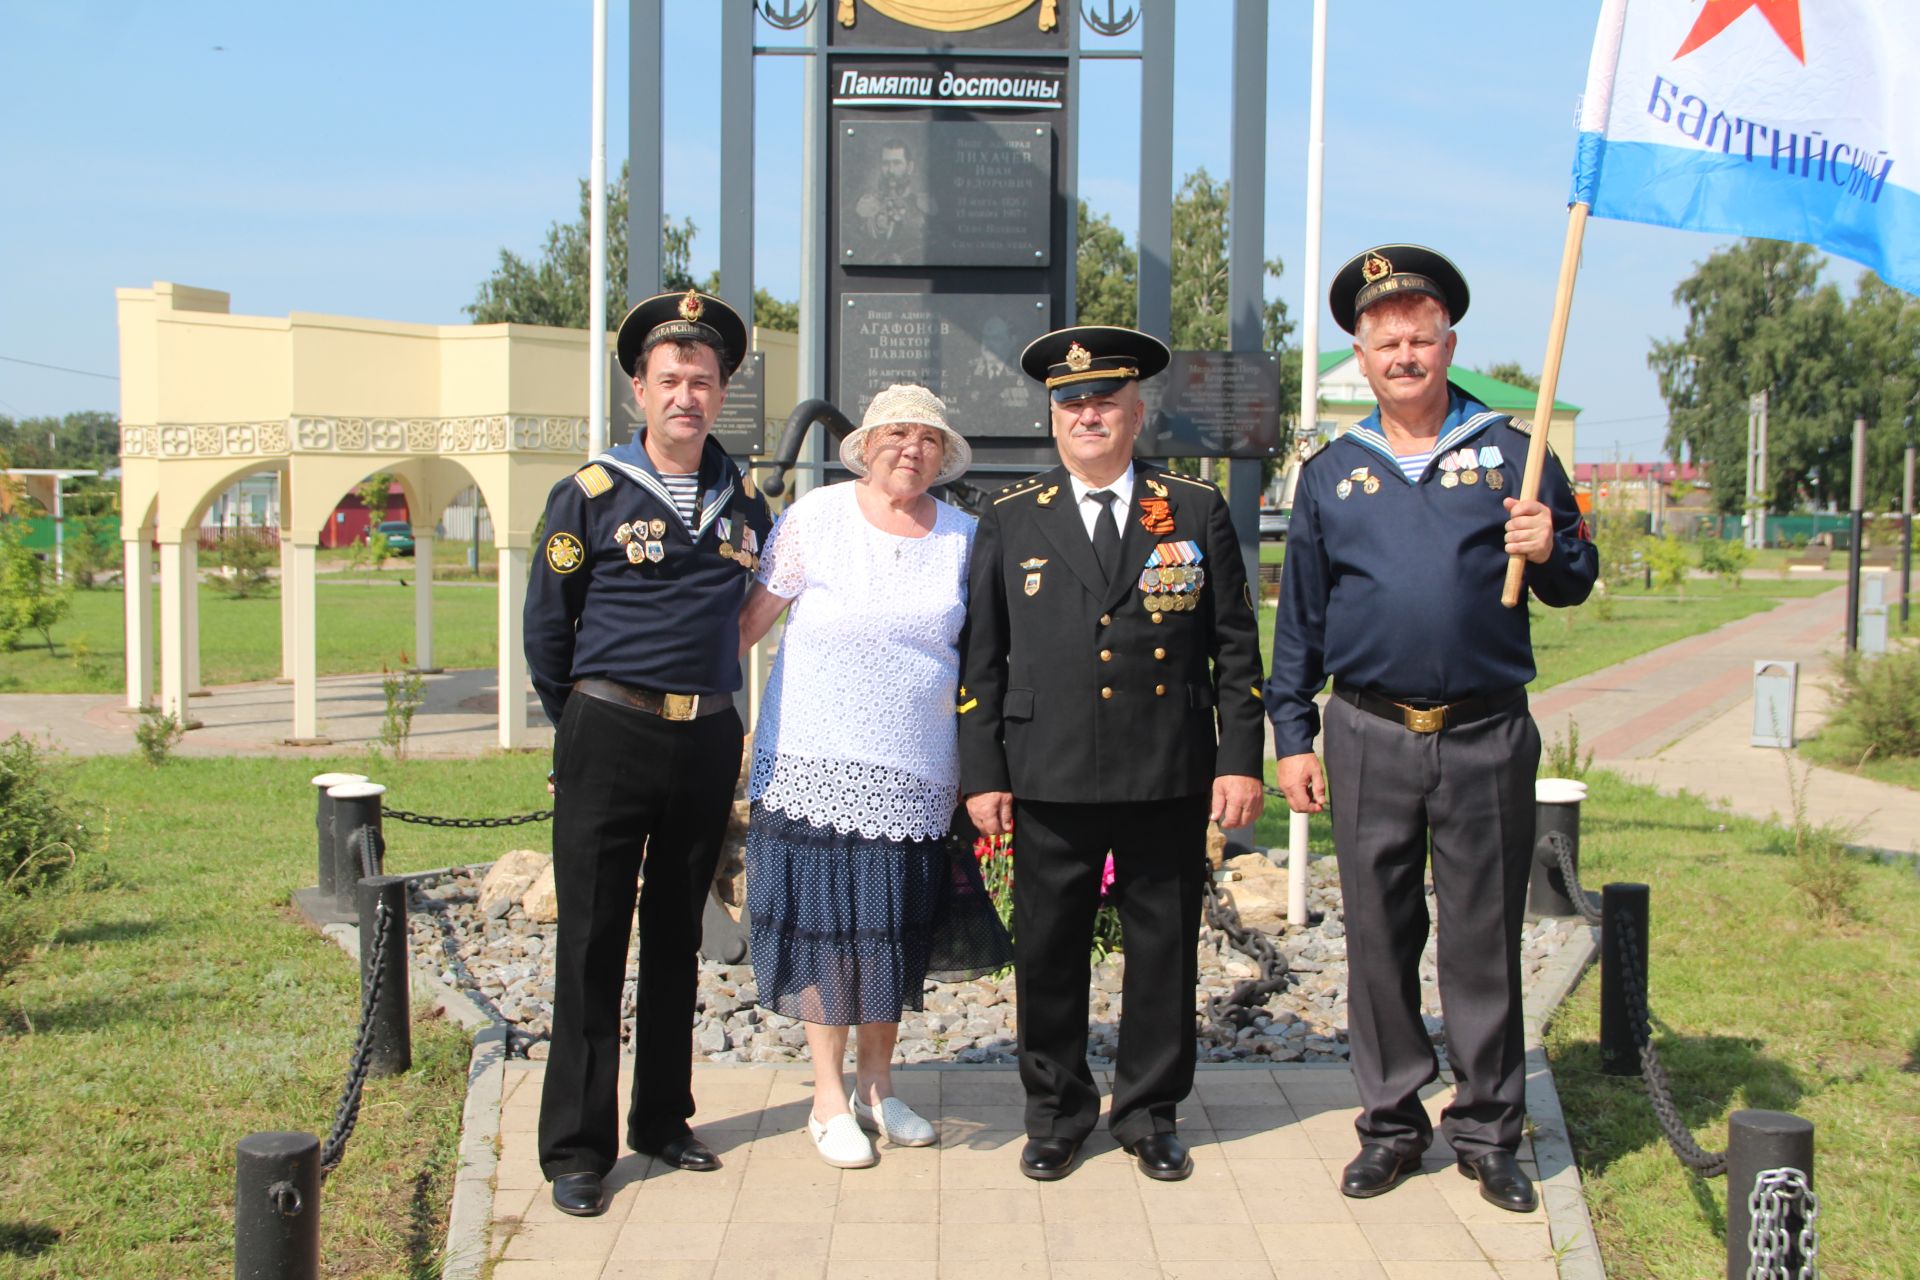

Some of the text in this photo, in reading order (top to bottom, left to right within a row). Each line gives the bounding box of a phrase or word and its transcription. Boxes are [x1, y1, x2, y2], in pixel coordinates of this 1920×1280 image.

[840, 71, 1060, 98] Памяти достоины
[1647, 75, 1895, 204] Балтийский
[955, 151, 1032, 164] ЛИХАЧЕВ
[860, 322, 950, 335] АГАФОНОВ
